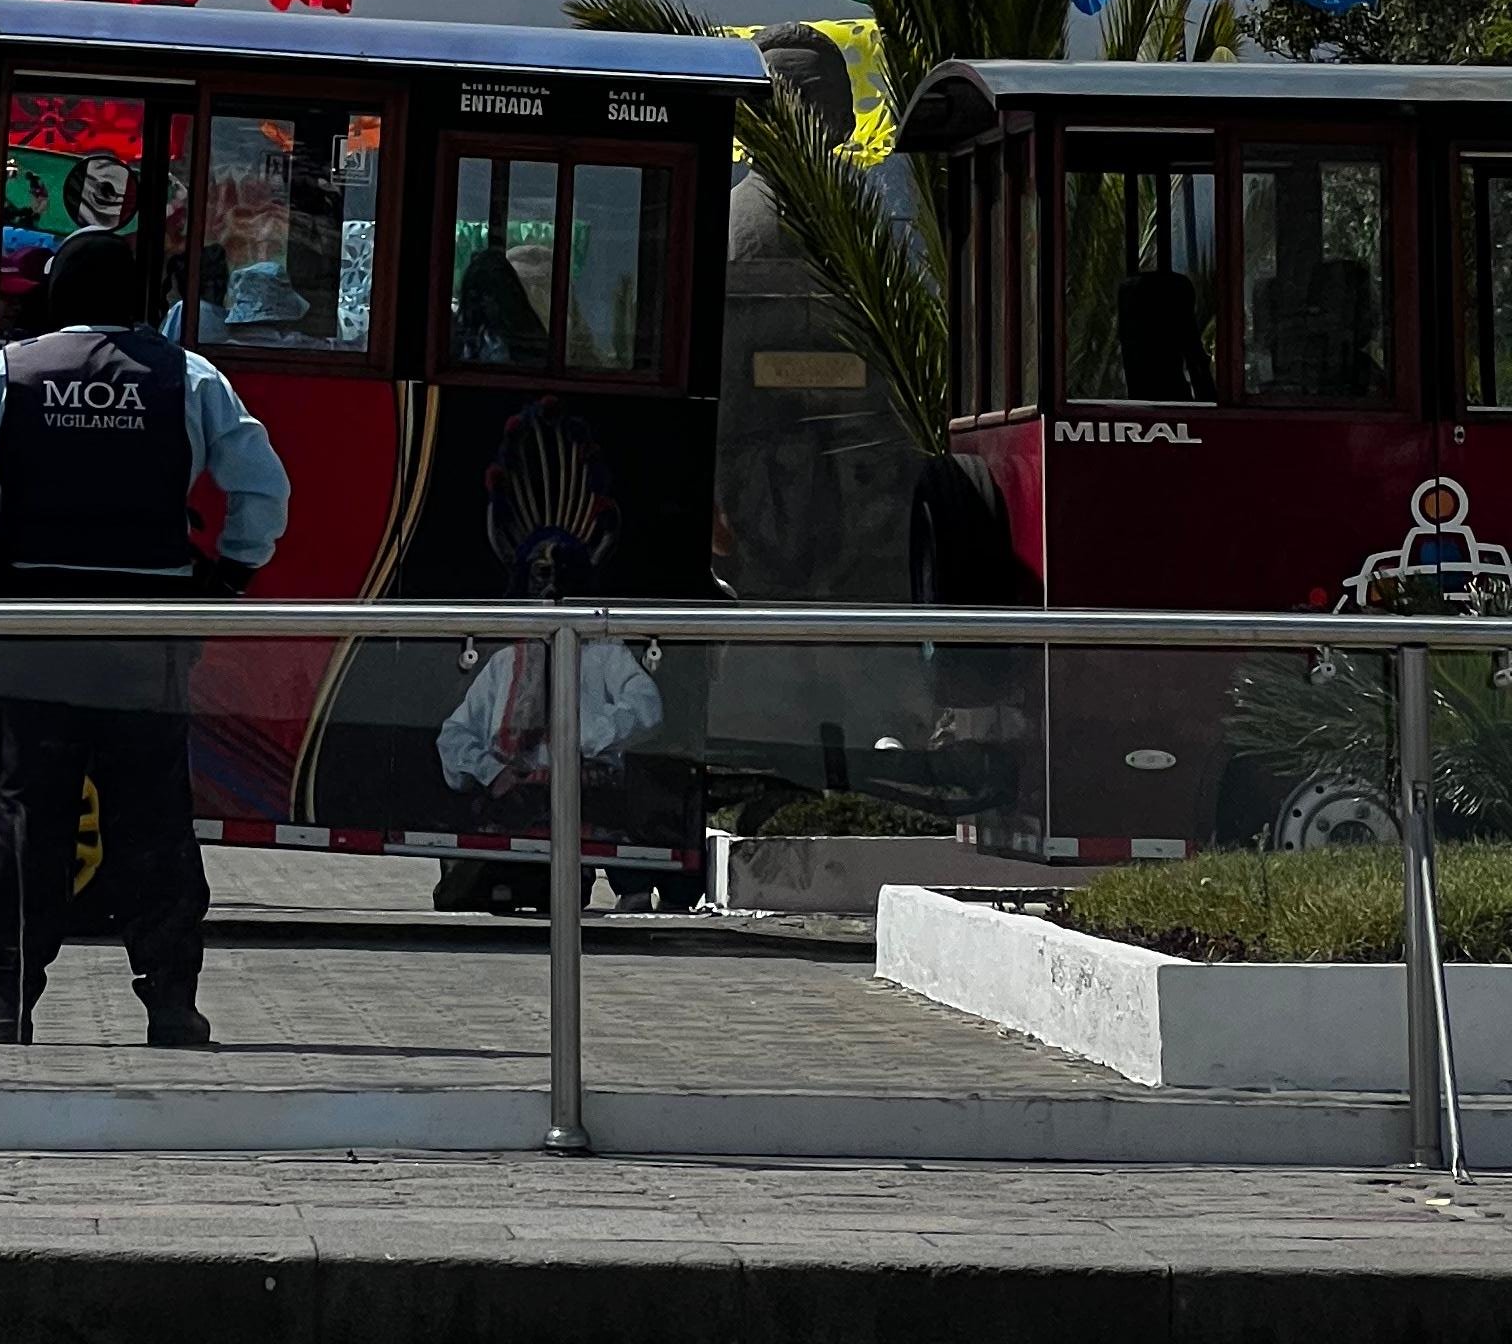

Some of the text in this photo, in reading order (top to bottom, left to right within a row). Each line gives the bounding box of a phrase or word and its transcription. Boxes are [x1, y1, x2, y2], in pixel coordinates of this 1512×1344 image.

[460, 94, 544, 116] ENTRADA
[607, 103, 669, 123] SALIDA
[43, 380, 146, 410] MOA
[44, 413, 145, 430] VIGILANCIA
[1054, 421, 1203, 444] MIRAL
